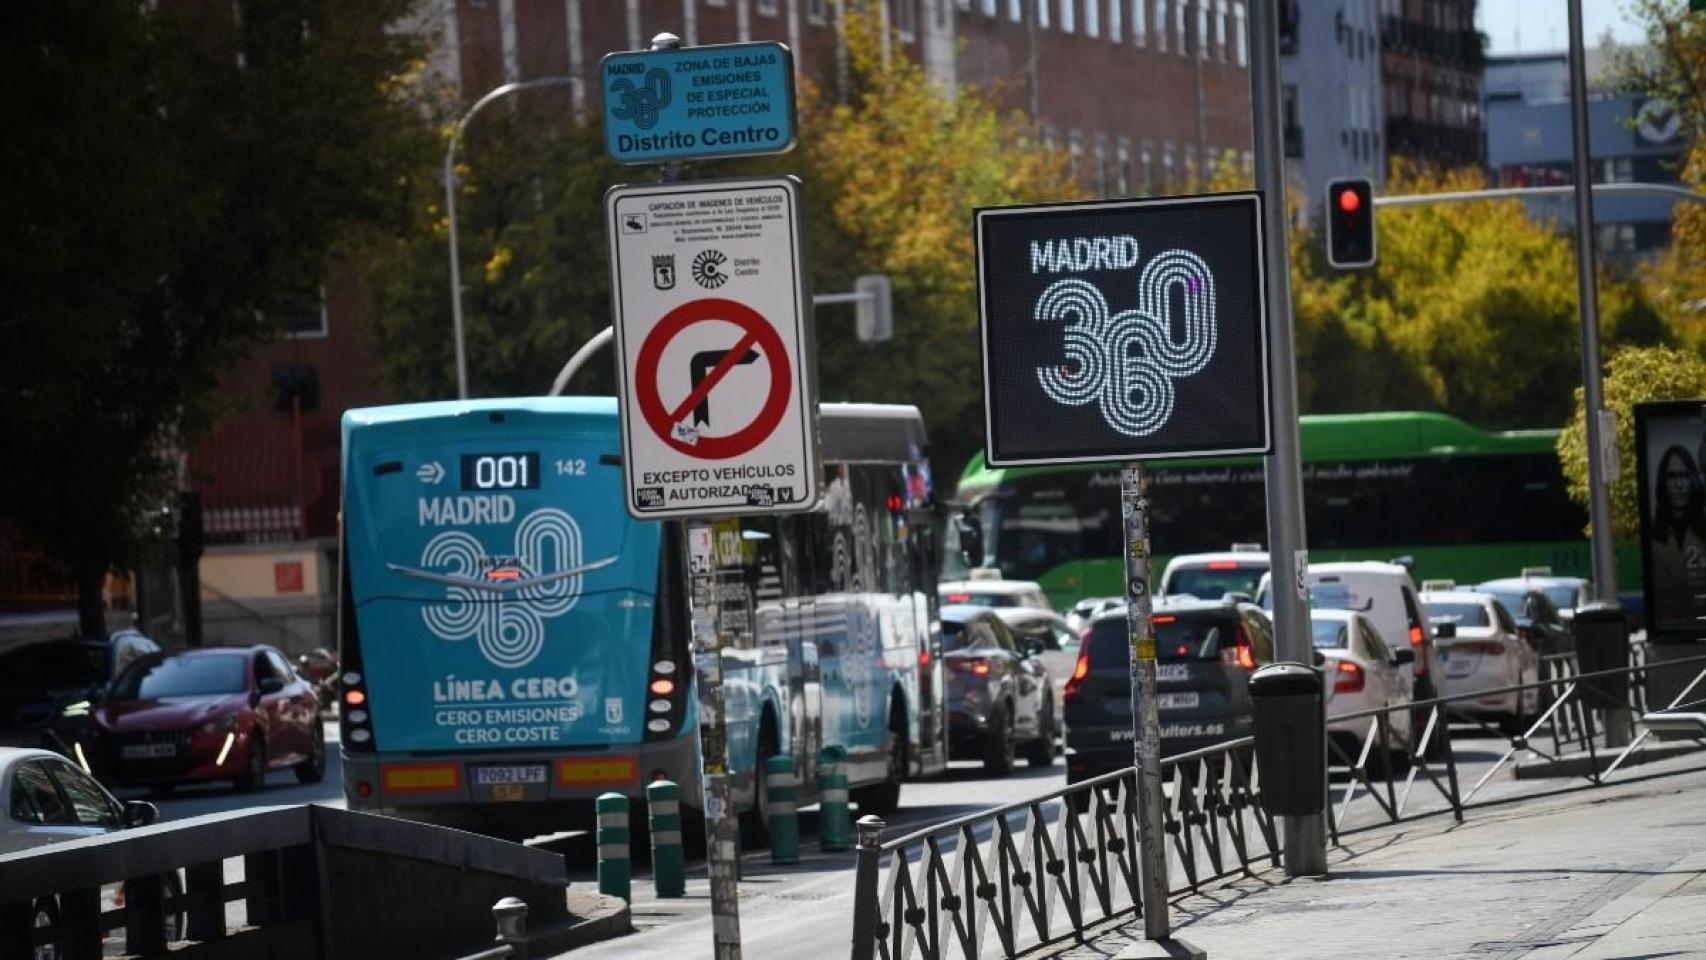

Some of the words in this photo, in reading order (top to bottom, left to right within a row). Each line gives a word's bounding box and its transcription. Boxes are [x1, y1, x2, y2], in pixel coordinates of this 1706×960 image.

[607, 62, 646, 76] MADRID
[675, 60, 710, 73] ZONA
[712, 57, 730, 70] DE
[734, 54, 777, 68] BAJAS
[692, 71, 762, 87] EMISIONES
[609, 67, 672, 130] 360
[687, 91, 705, 104] DE
[708, 86, 770, 102] ESPECIAL
[687, 102, 771, 118] PROTECCIÓN
[618, 130, 696, 153] Distrito
[701, 125, 780, 146] Centro
[687, 201, 696, 209] DE
[734, 197, 745, 206] DE
[1029, 234, 1140, 274] MADRID
[1034, 248, 1218, 438] 360
[475, 454, 529, 488] 001
[555, 458, 588, 476] 142
[643, 470, 710, 485] EXCEPTO
[712, 463, 796, 481] VEHÍCULOS
[669, 483, 771, 501] AUTORIZAD
[418, 494, 516, 527] MADRID
[420, 507, 584, 668] 360
[433, 673, 506, 702] LÍNEA
[511, 676, 578, 699] CERO
[435, 710, 482, 726] CERO
[485, 706, 578, 724] EMISIONES
[455, 727, 501, 743] CERO
[505, 725, 561, 742] COSTE
[482, 769, 514, 782] 7092
[517, 767, 543, 781] LPF
